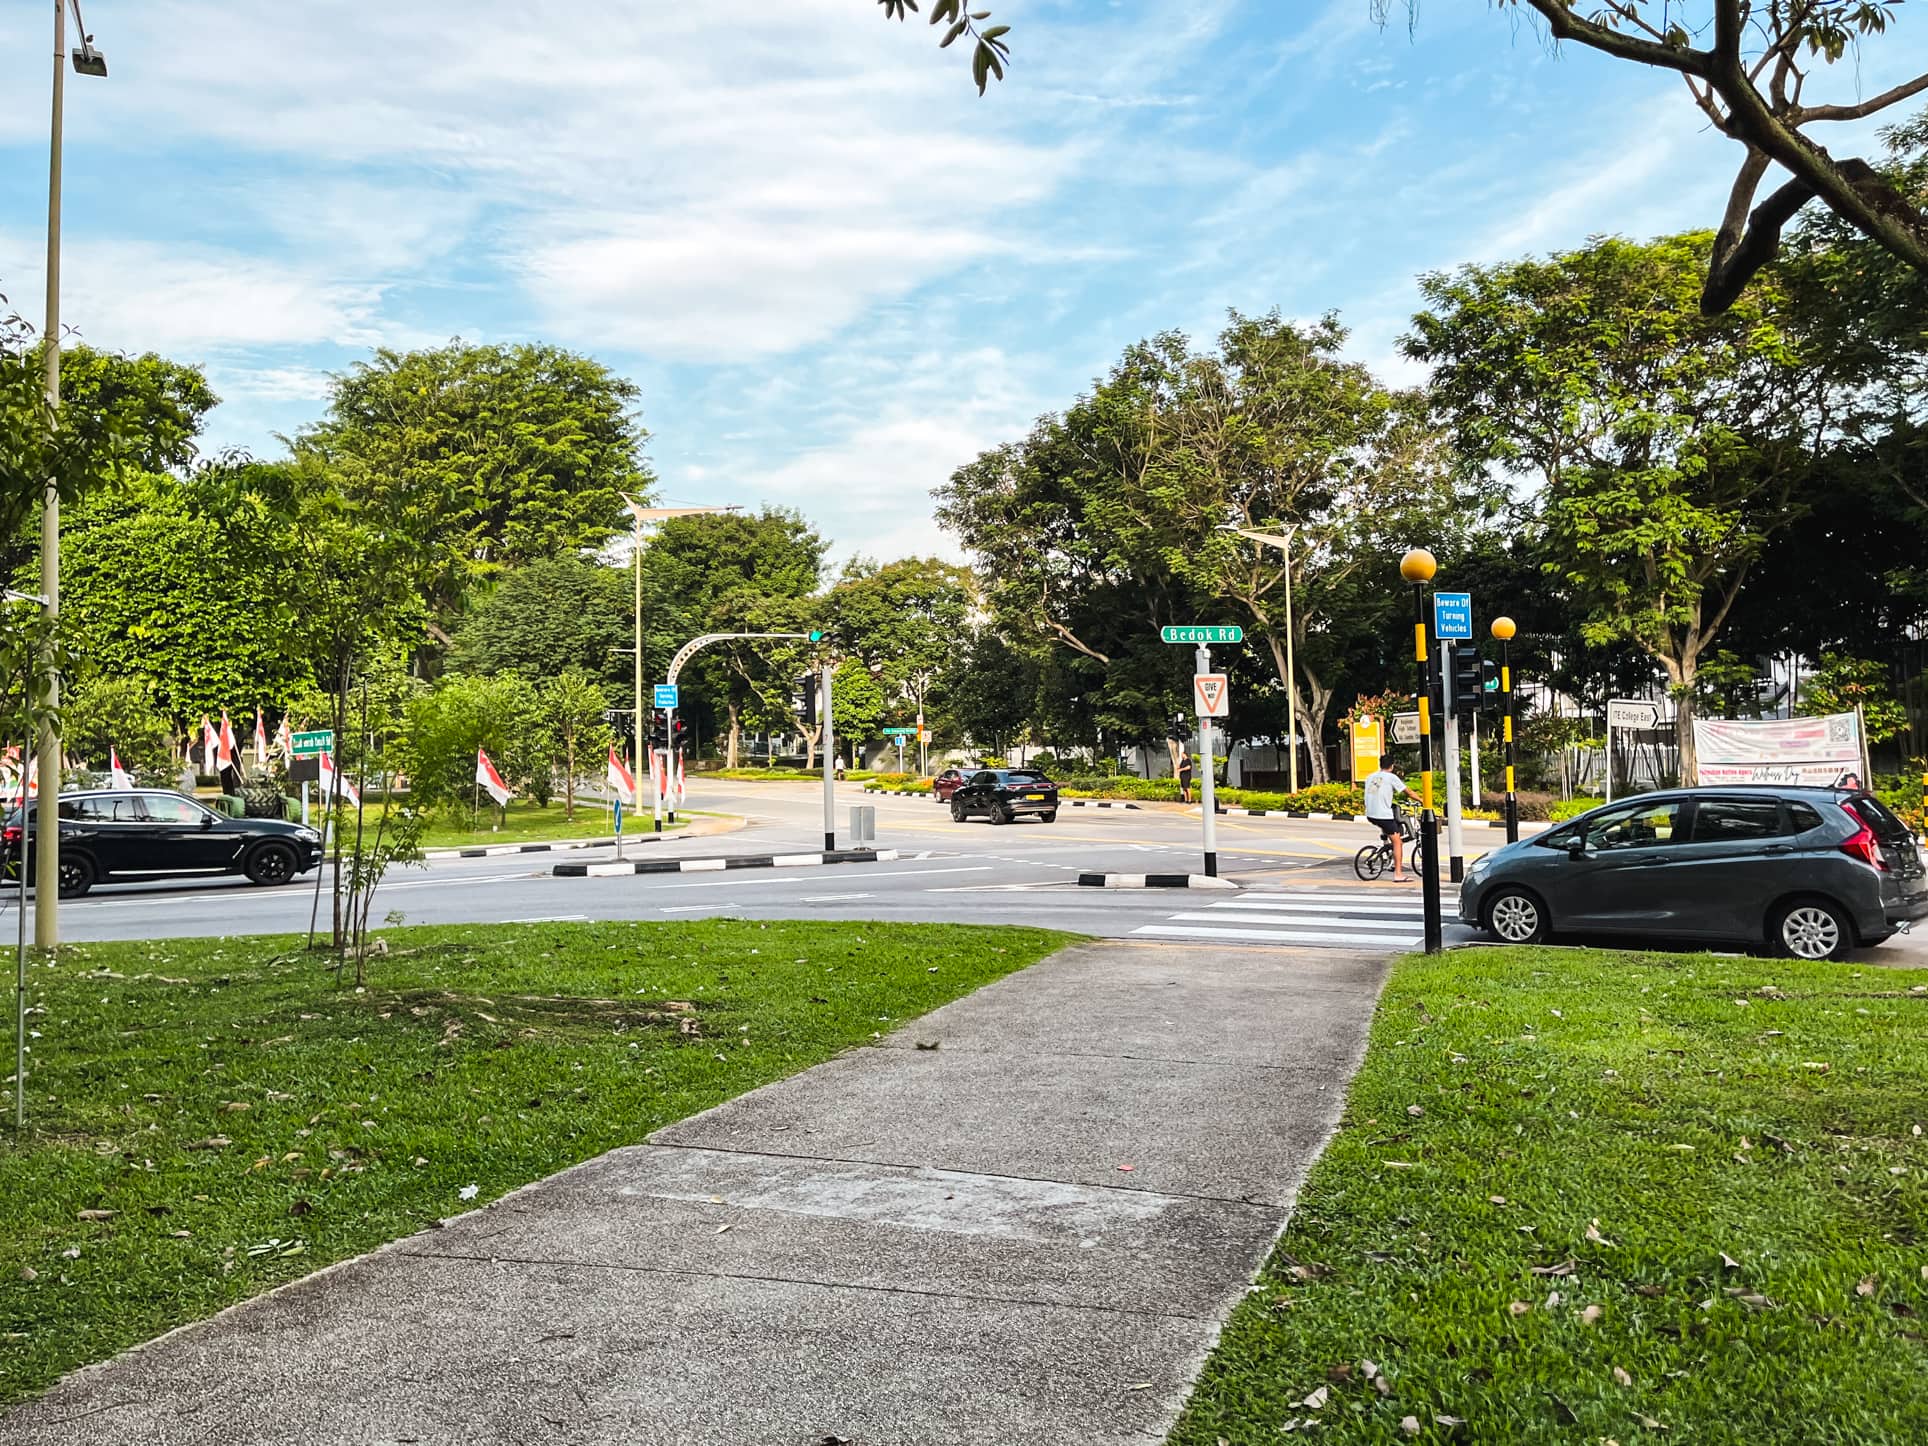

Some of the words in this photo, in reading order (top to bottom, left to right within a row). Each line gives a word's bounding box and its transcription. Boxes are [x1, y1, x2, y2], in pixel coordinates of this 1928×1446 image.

[1436, 597, 1460, 607] Beware
[1461, 597, 1469, 608] Of
[1442, 610, 1465, 623] Turning
[1440, 623, 1467, 633] Vehicles
[1170, 628, 1213, 641] Bedok
[1219, 628, 1235, 641] Rd
[1204, 682, 1217, 692] GIVE
[1622, 711, 1639, 723] College
[1640, 712, 1652, 722] East
[1784, 765, 1800, 785] Day
